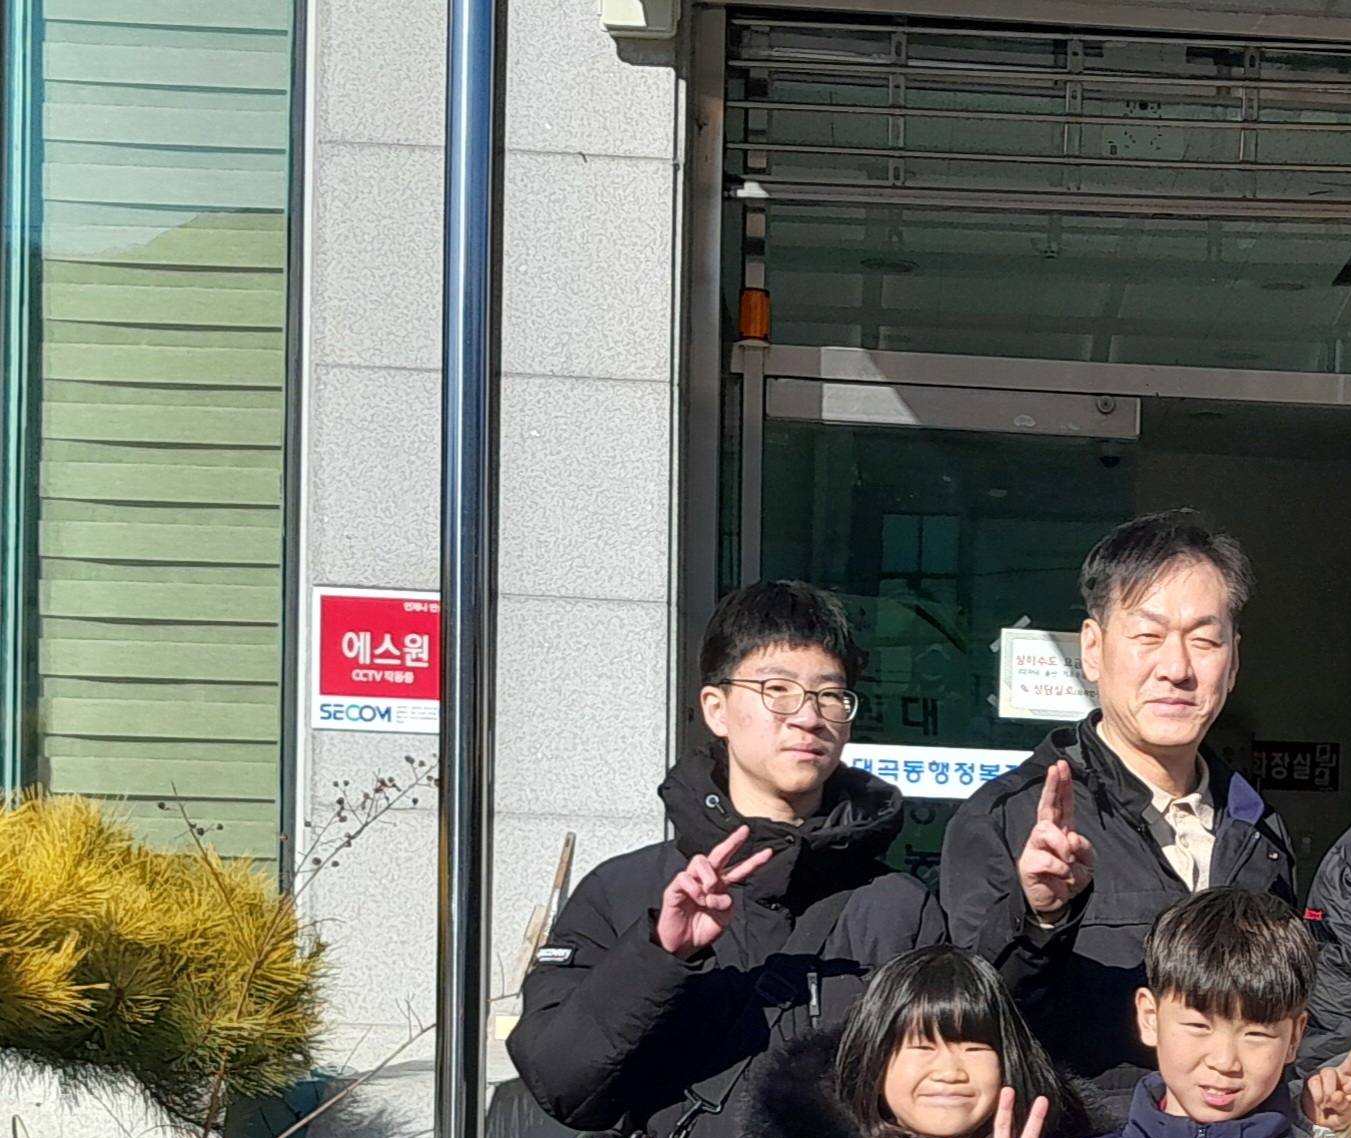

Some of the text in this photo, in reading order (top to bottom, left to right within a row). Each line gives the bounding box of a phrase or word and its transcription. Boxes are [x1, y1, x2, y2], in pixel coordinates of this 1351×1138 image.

[341, 631, 430, 668] 에스원
[351, 669, 383, 682] CCTV
[319, 703, 392, 723] SECOM
[853, 757, 1020, 785] 대곡동행정복
